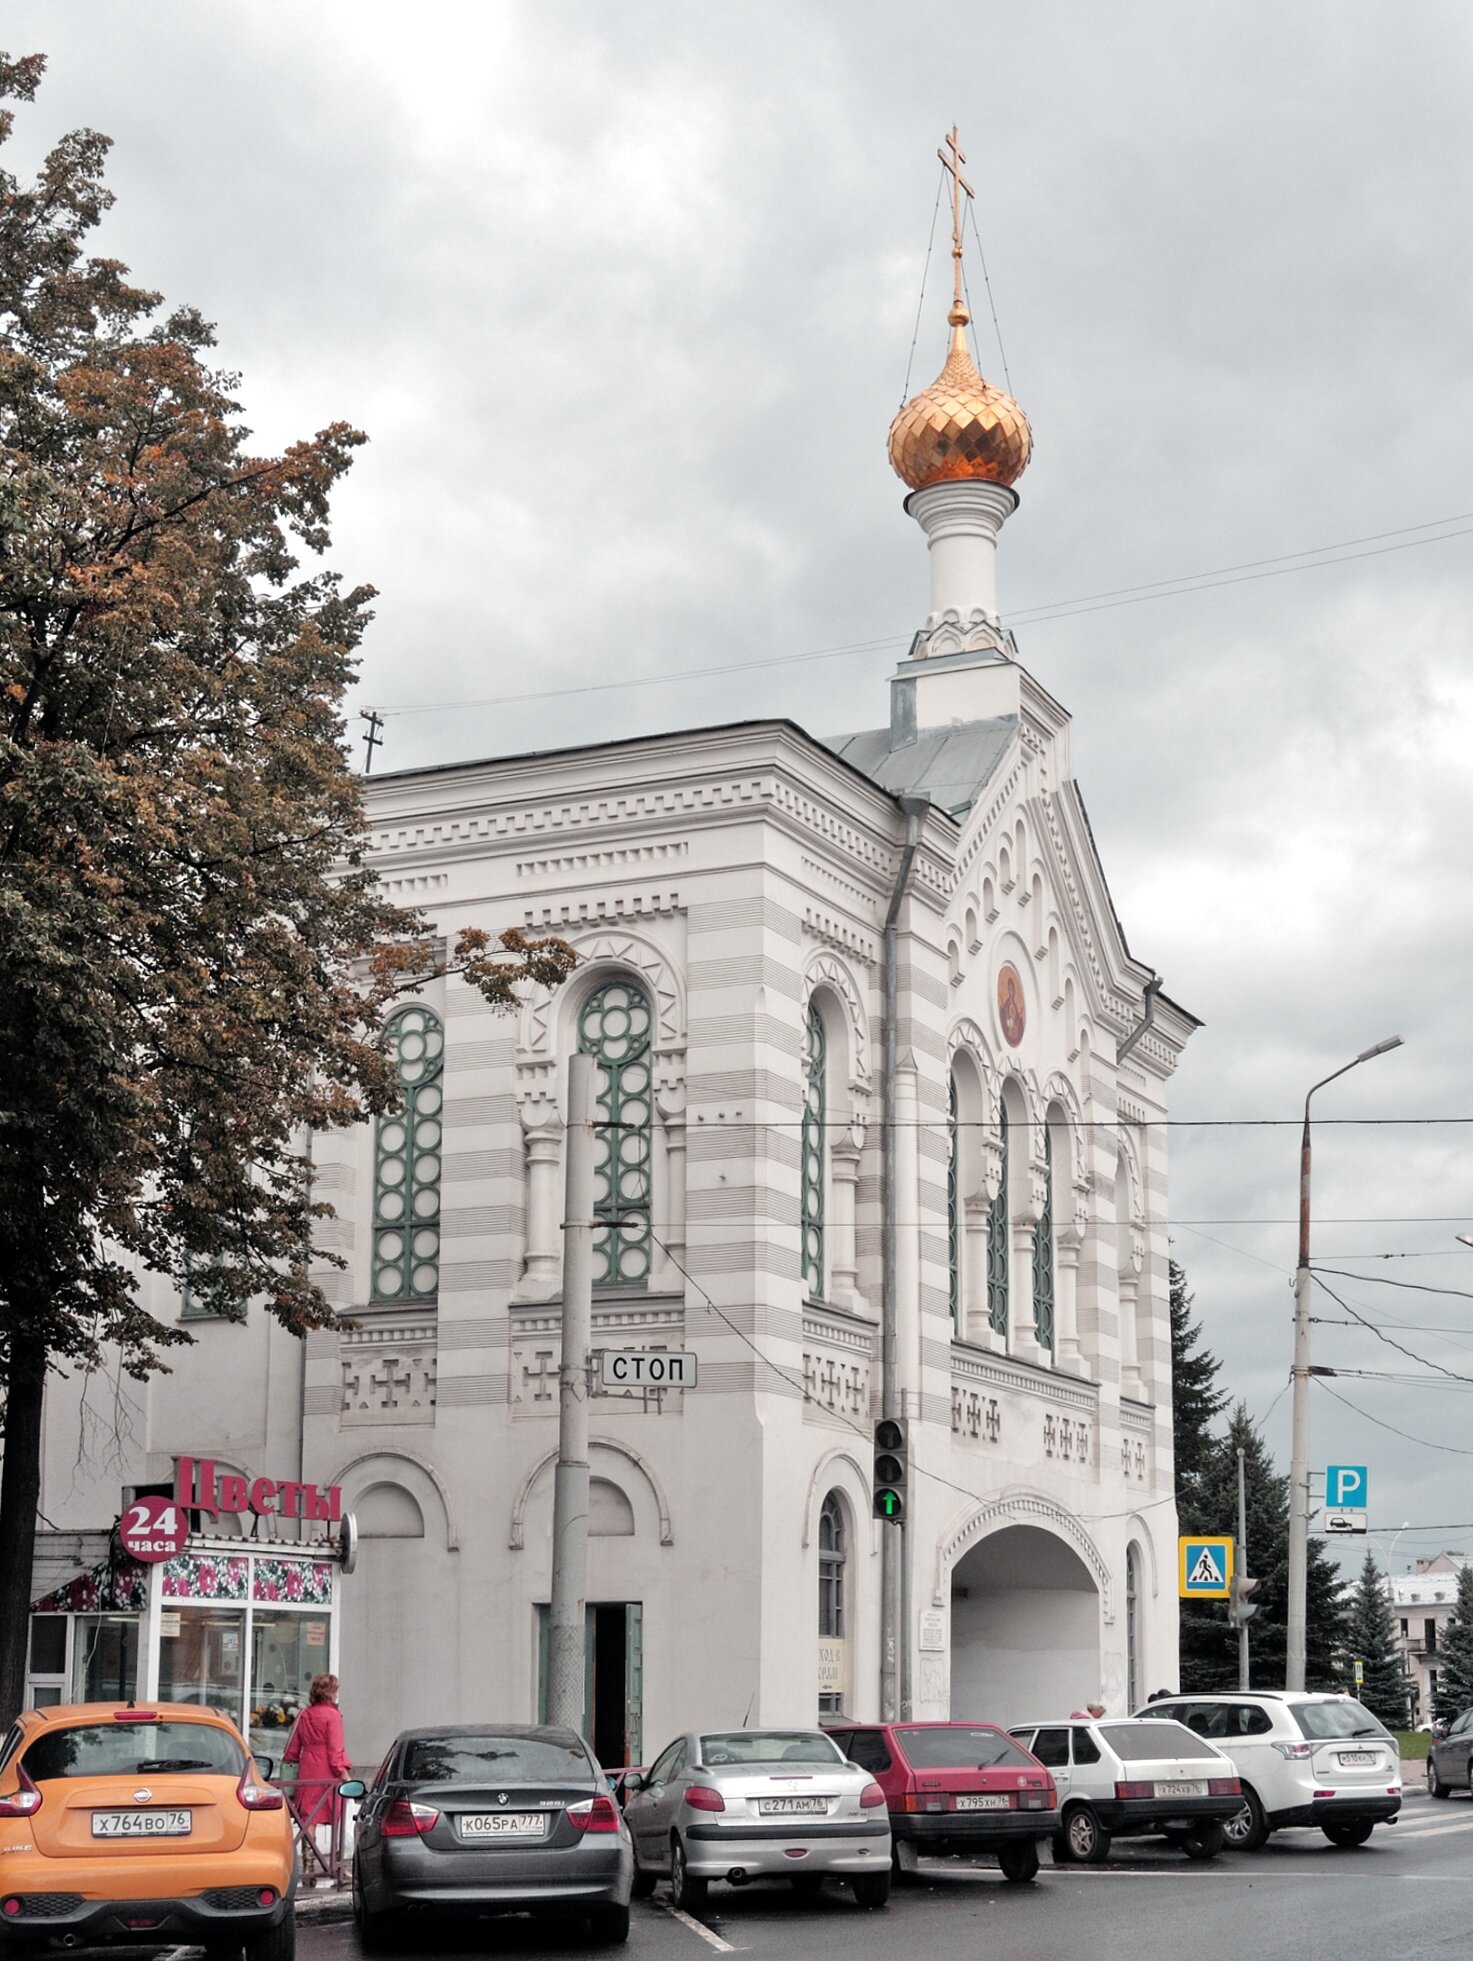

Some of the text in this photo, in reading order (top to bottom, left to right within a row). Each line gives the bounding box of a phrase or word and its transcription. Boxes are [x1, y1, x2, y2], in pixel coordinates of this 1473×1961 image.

[613, 1357, 683, 1380] СТОП
[174, 1455, 342, 1524] Цветы
[1337, 1469, 1361, 1504] P
[127, 1506, 178, 1535] 24
[127, 1540, 177, 1553] часа
[764, 1798, 823, 1811] С271АМ 76
[100, 1813, 185, 1831] Х764ВО 76
[466, 1815, 541, 1831] К065РА 777
